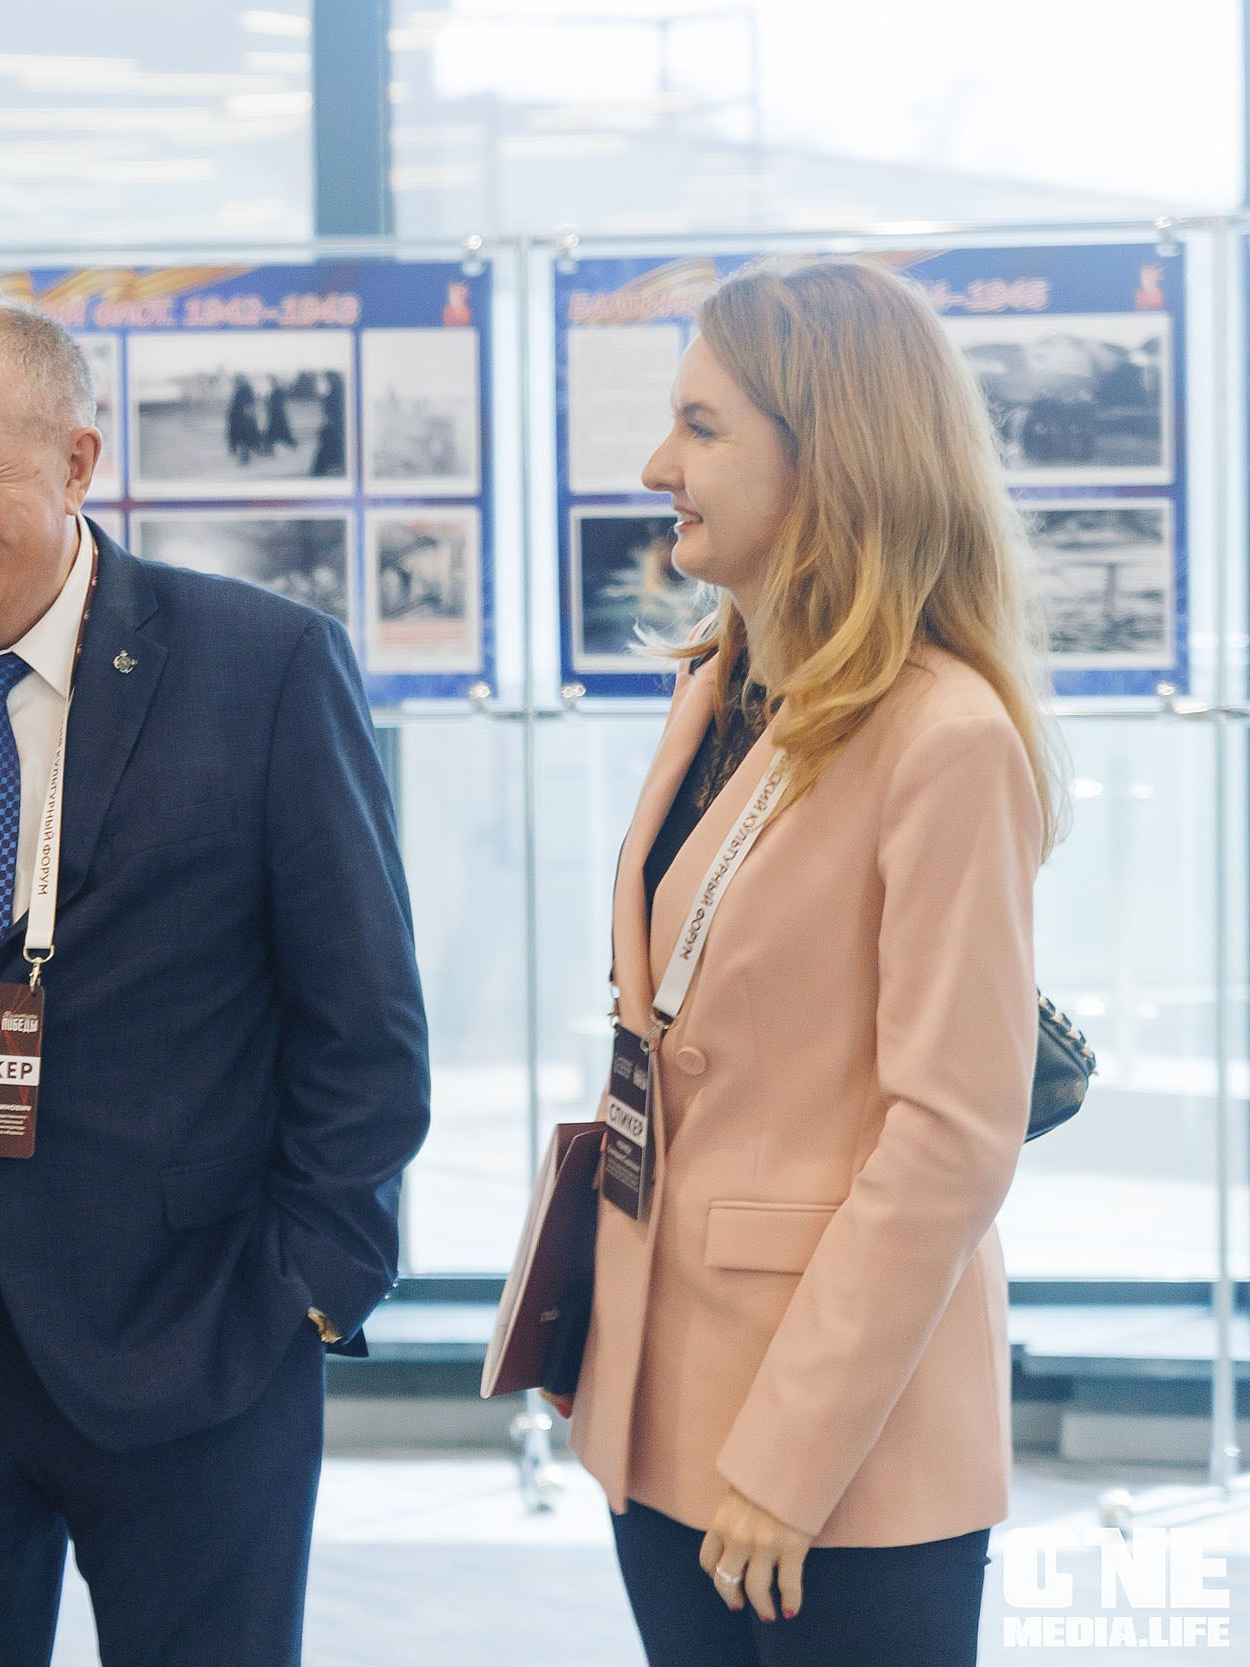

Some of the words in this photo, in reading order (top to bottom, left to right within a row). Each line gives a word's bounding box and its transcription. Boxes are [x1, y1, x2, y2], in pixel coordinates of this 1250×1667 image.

[37, 844, 52, 896] ФОРУМ
[679, 906, 706, 961] ФОРУМ
[1, 1018, 38, 1034] ПОБЕДЫ
